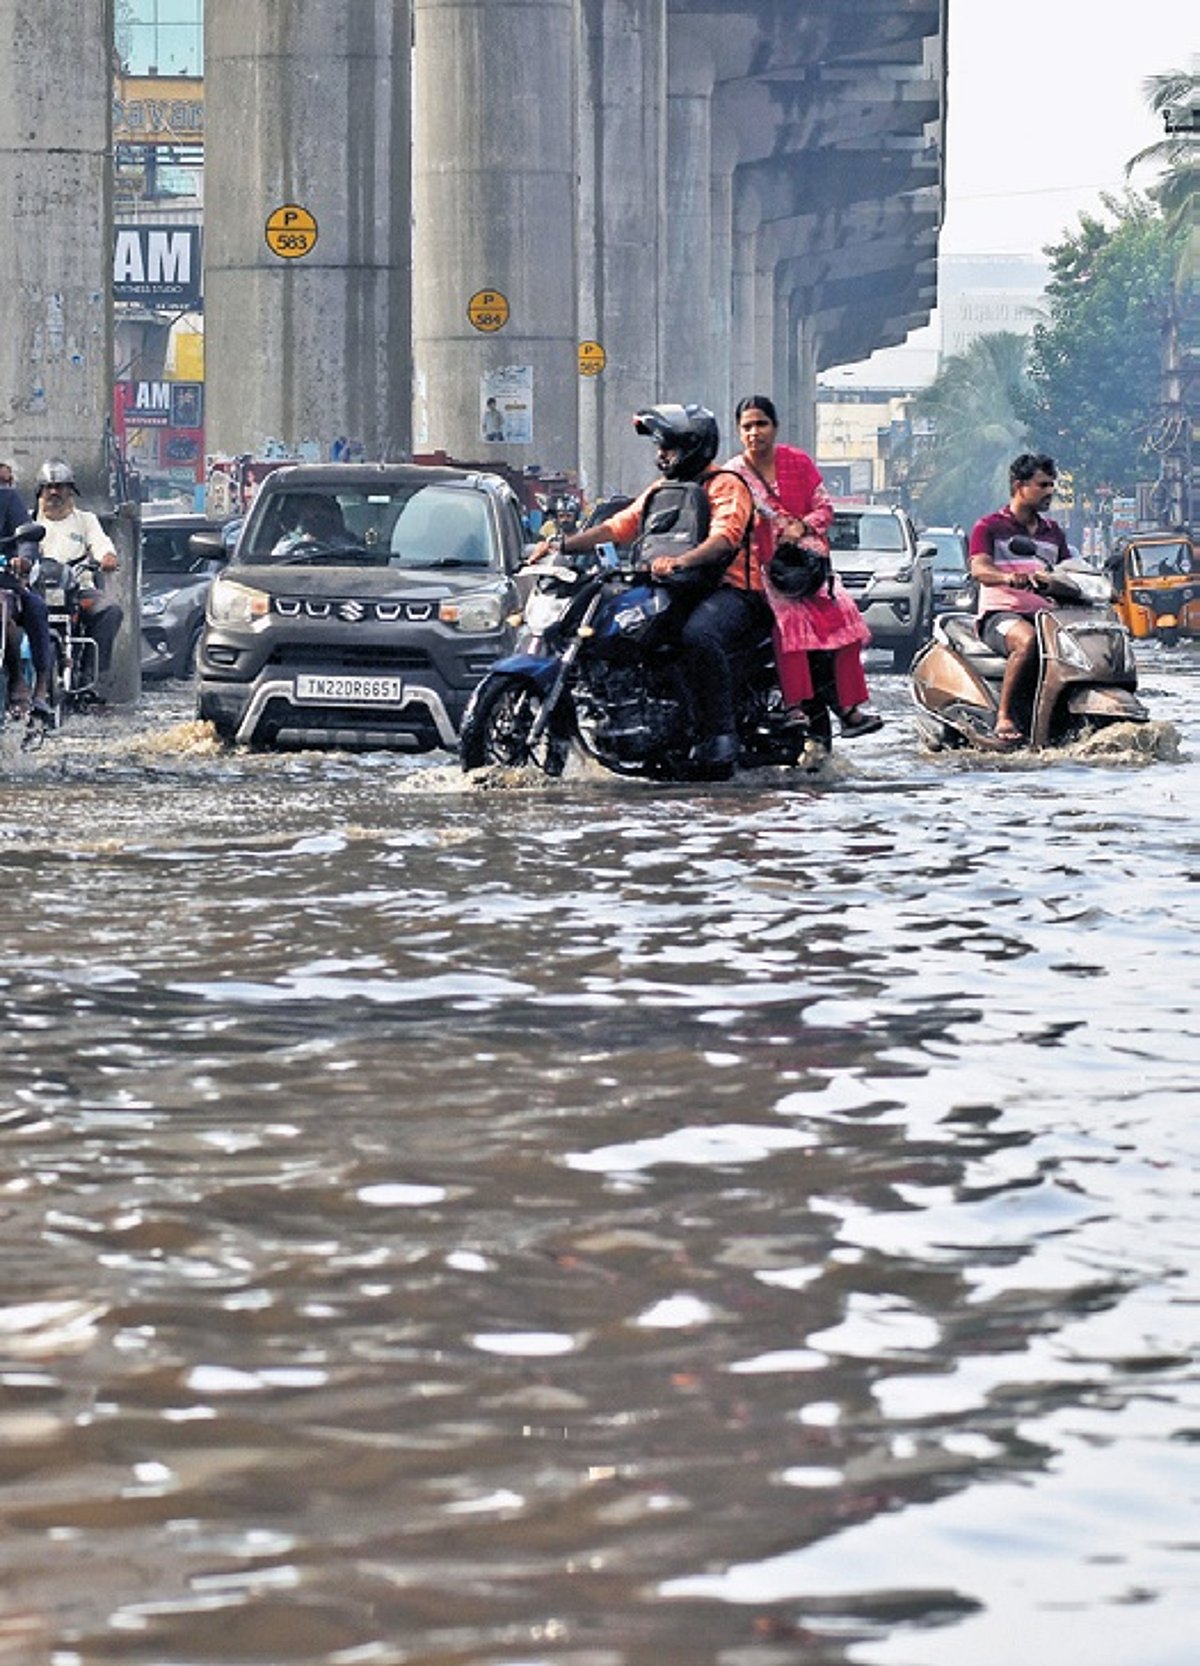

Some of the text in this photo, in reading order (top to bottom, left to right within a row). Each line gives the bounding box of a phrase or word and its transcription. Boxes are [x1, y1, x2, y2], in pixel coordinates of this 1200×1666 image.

[285, 212, 298, 226] P
[277, 235, 307, 249] 583
[114, 230, 191, 283] AM
[484, 294, 495, 304] P
[476, 314, 501, 325] 584
[584, 345, 594, 355] P
